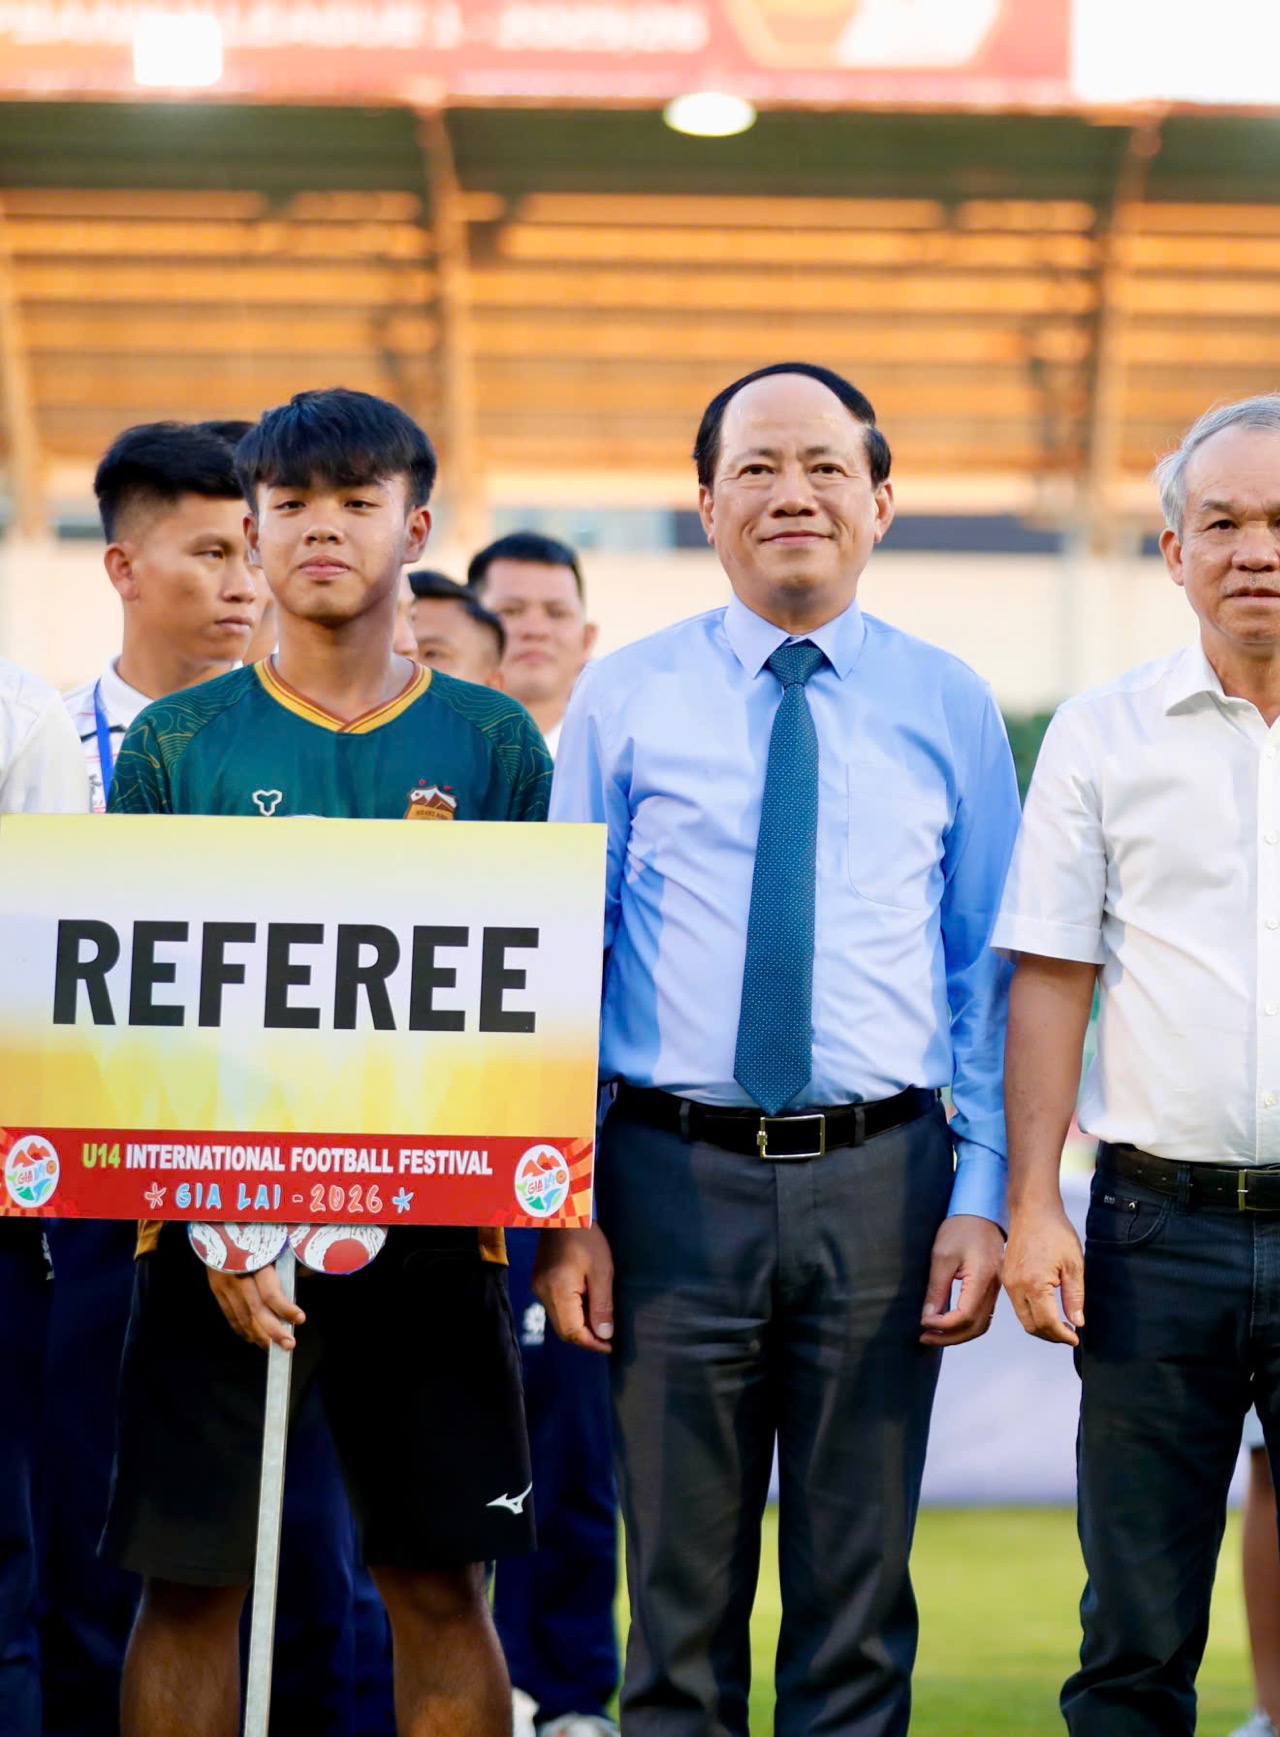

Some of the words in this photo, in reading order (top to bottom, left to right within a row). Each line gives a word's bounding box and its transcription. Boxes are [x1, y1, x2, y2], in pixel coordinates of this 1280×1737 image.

[52, 919, 540, 1033] REFEREE
[82, 1142, 121, 1169] U14
[125, 1144, 286, 1172] INTERNATIONAL
[290, 1146, 394, 1174] FOOTBALL
[398, 1148, 493, 1176] FESTIVAL
[175, 1183, 222, 1209] GIA
[236, 1183, 282, 1210] LAI
[309, 1183, 384, 1214] 2026
